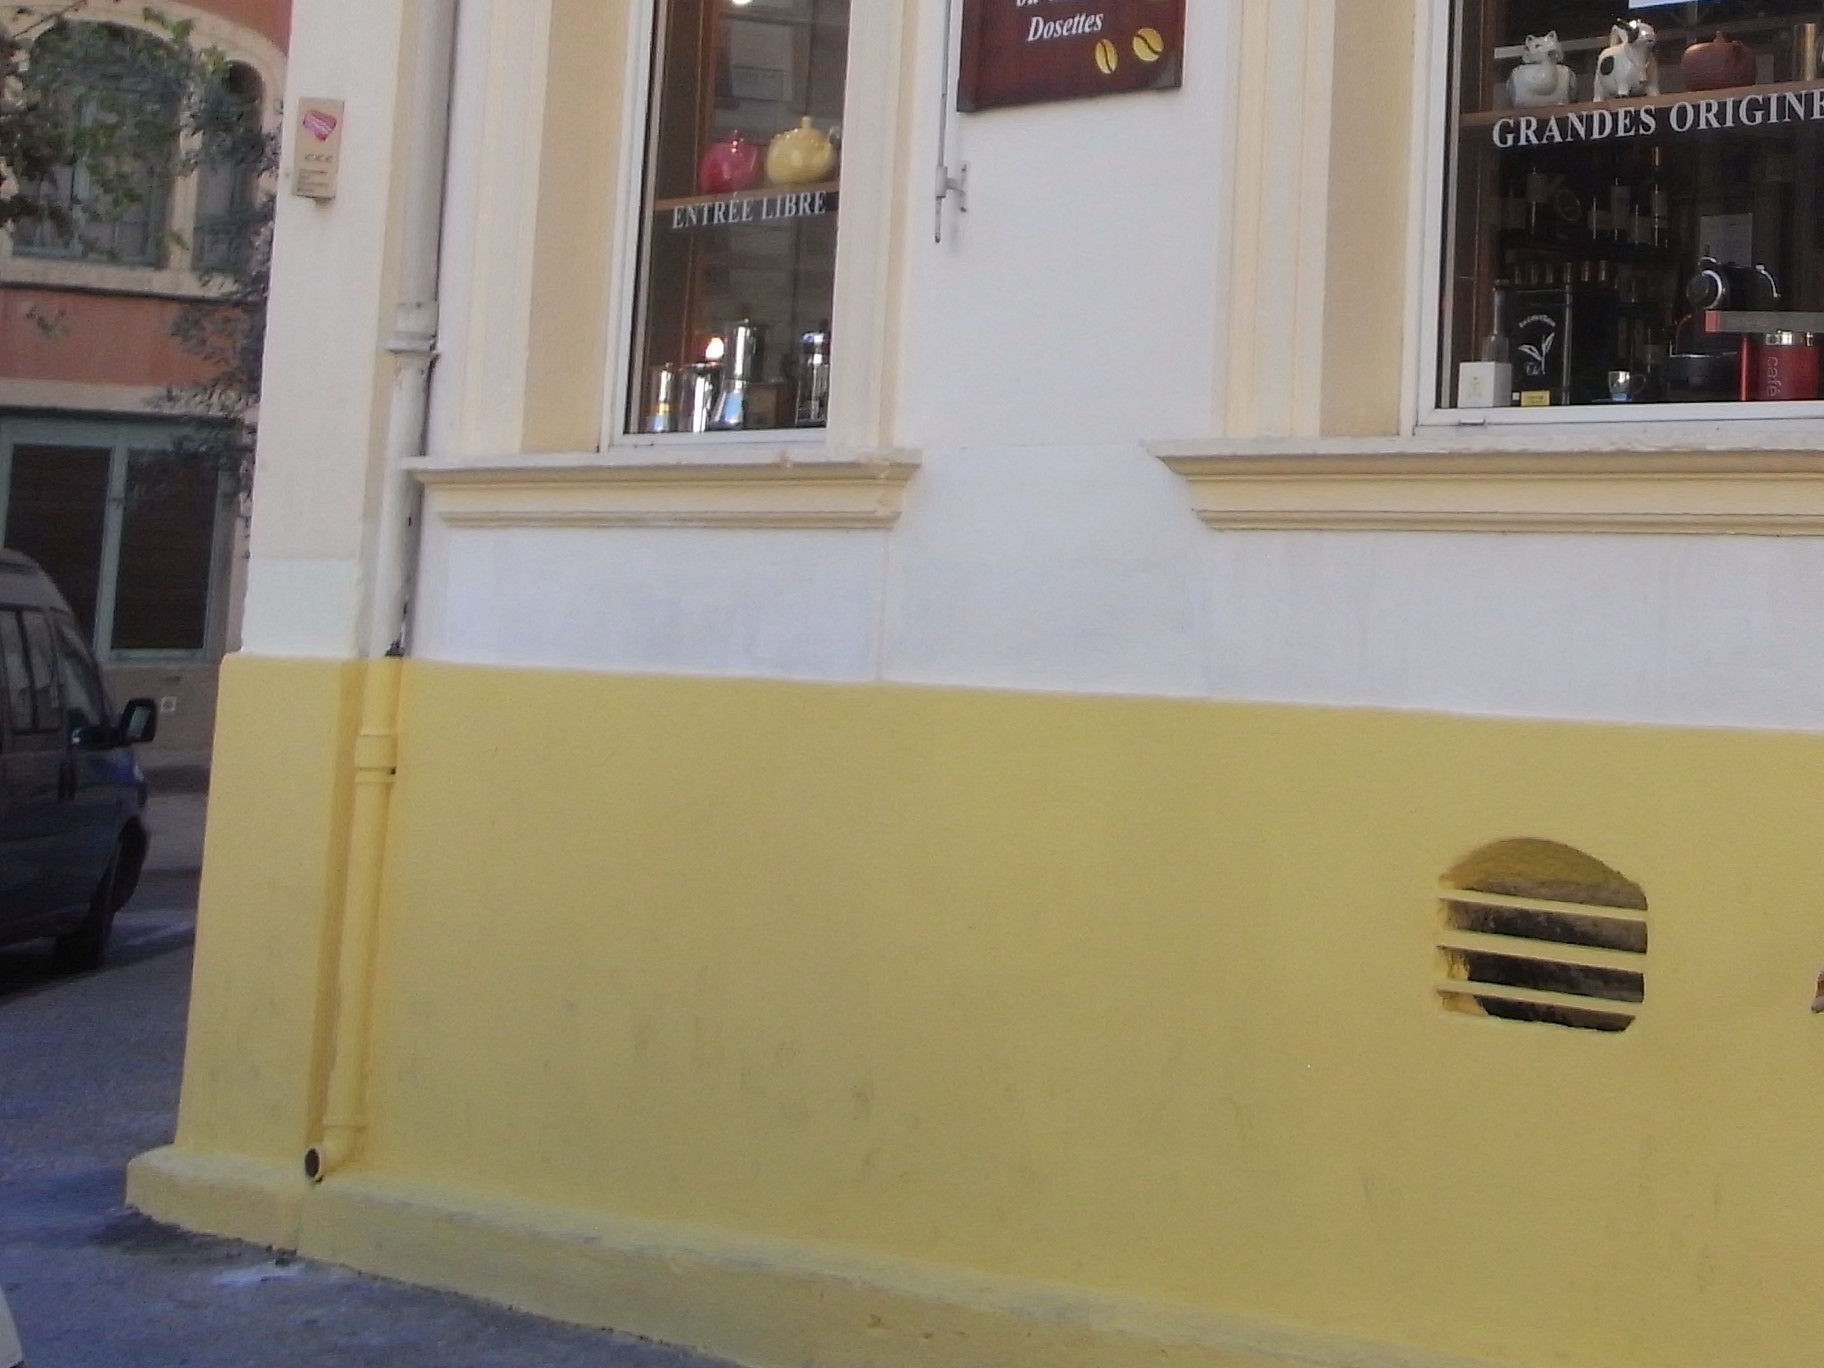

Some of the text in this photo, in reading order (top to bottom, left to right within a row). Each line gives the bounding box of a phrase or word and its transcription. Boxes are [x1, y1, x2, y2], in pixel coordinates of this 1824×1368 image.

[1026, 12, 1105, 42] Dosettes
[1492, 105, 1657, 149] GRANDES
[672, 190, 827, 229] ENTRÉE LIBRE
[1767, 356, 1781, 397] café
